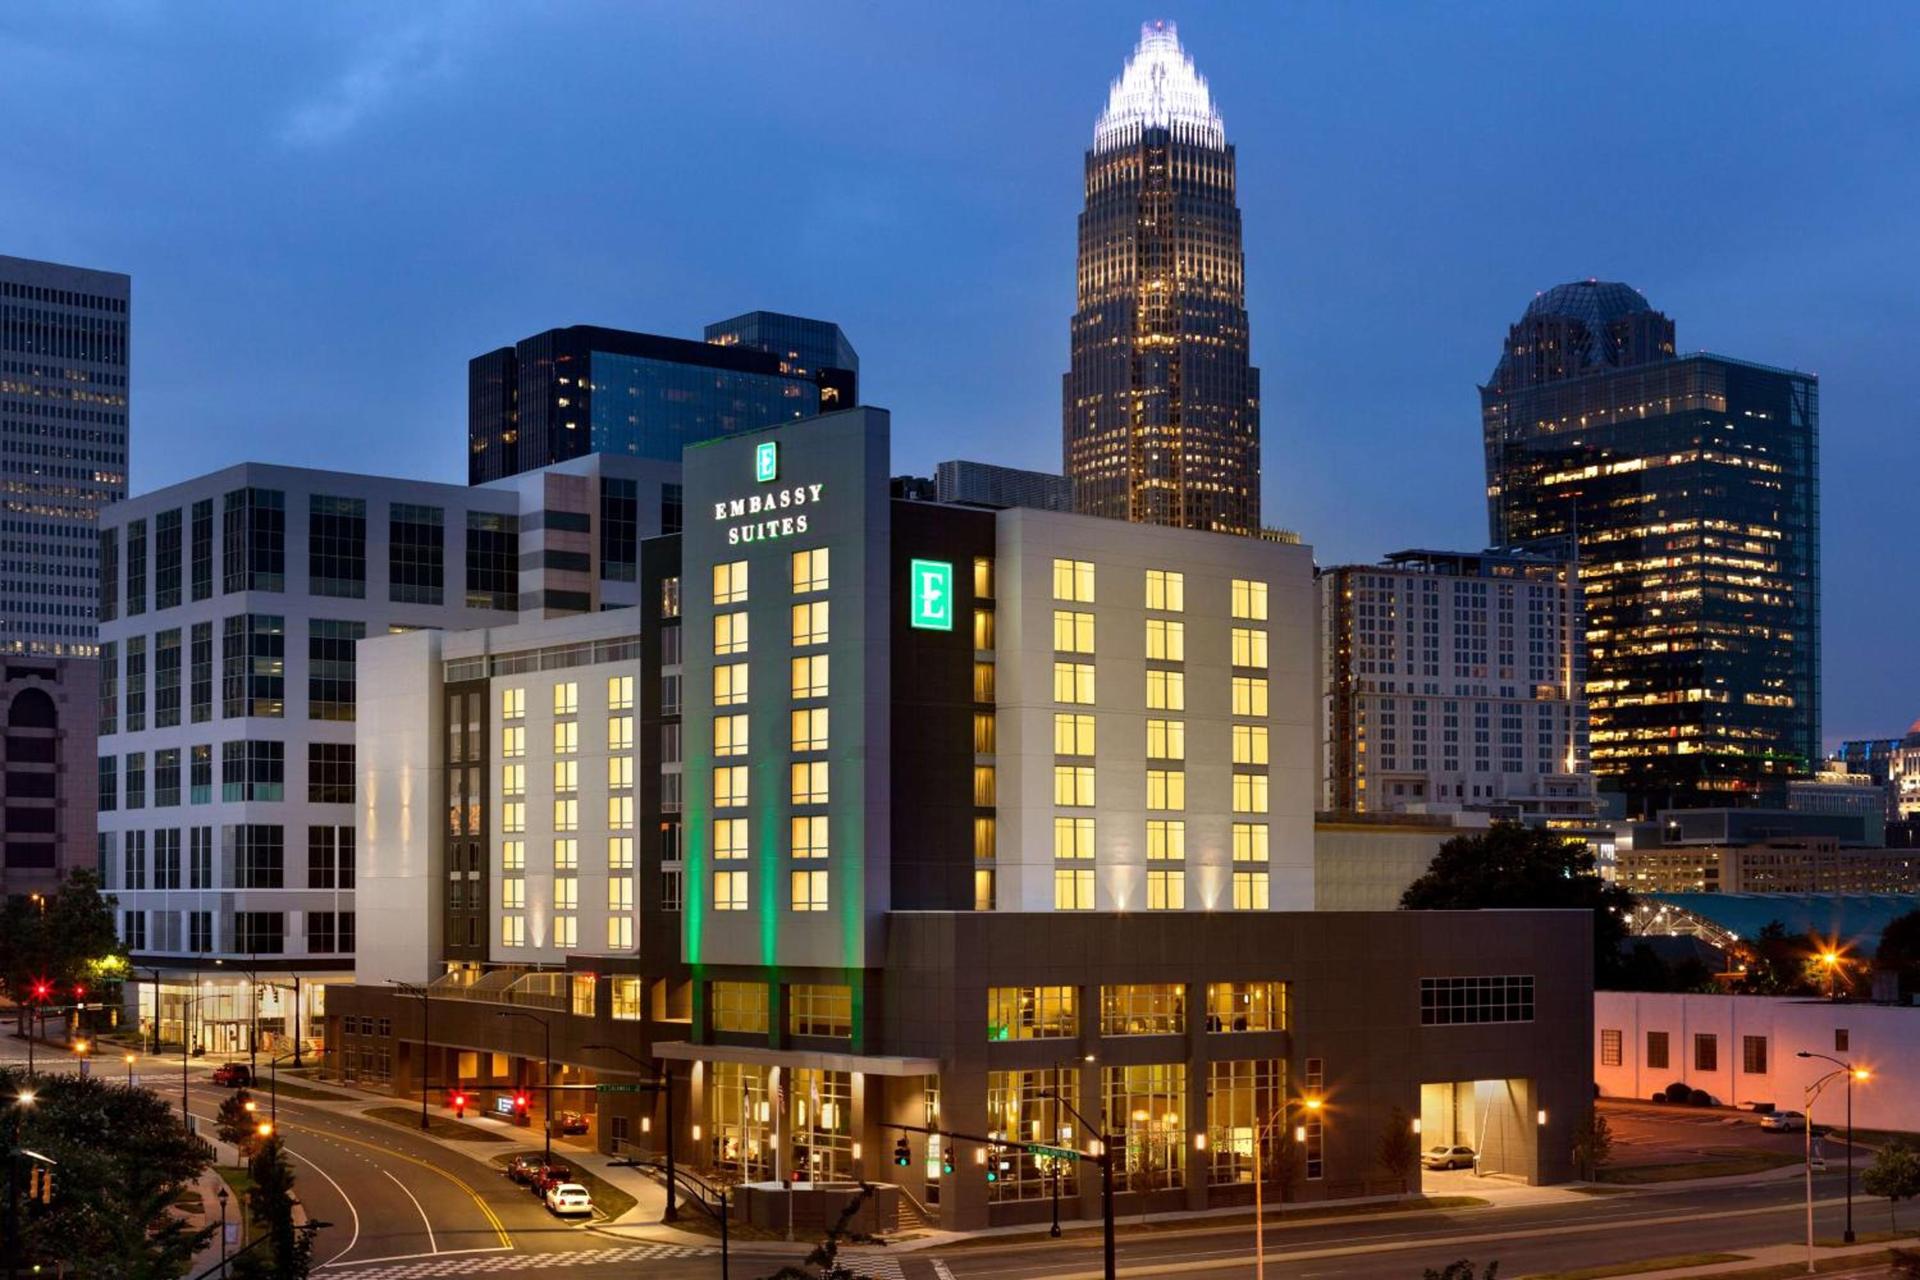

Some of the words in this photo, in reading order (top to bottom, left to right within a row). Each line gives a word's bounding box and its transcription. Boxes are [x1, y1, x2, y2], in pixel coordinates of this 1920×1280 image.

[762, 449, 774, 475] E
[714, 484, 823, 520] EMBASSY
[728, 515, 807, 545] SUITES
[919, 572, 944, 618] E
